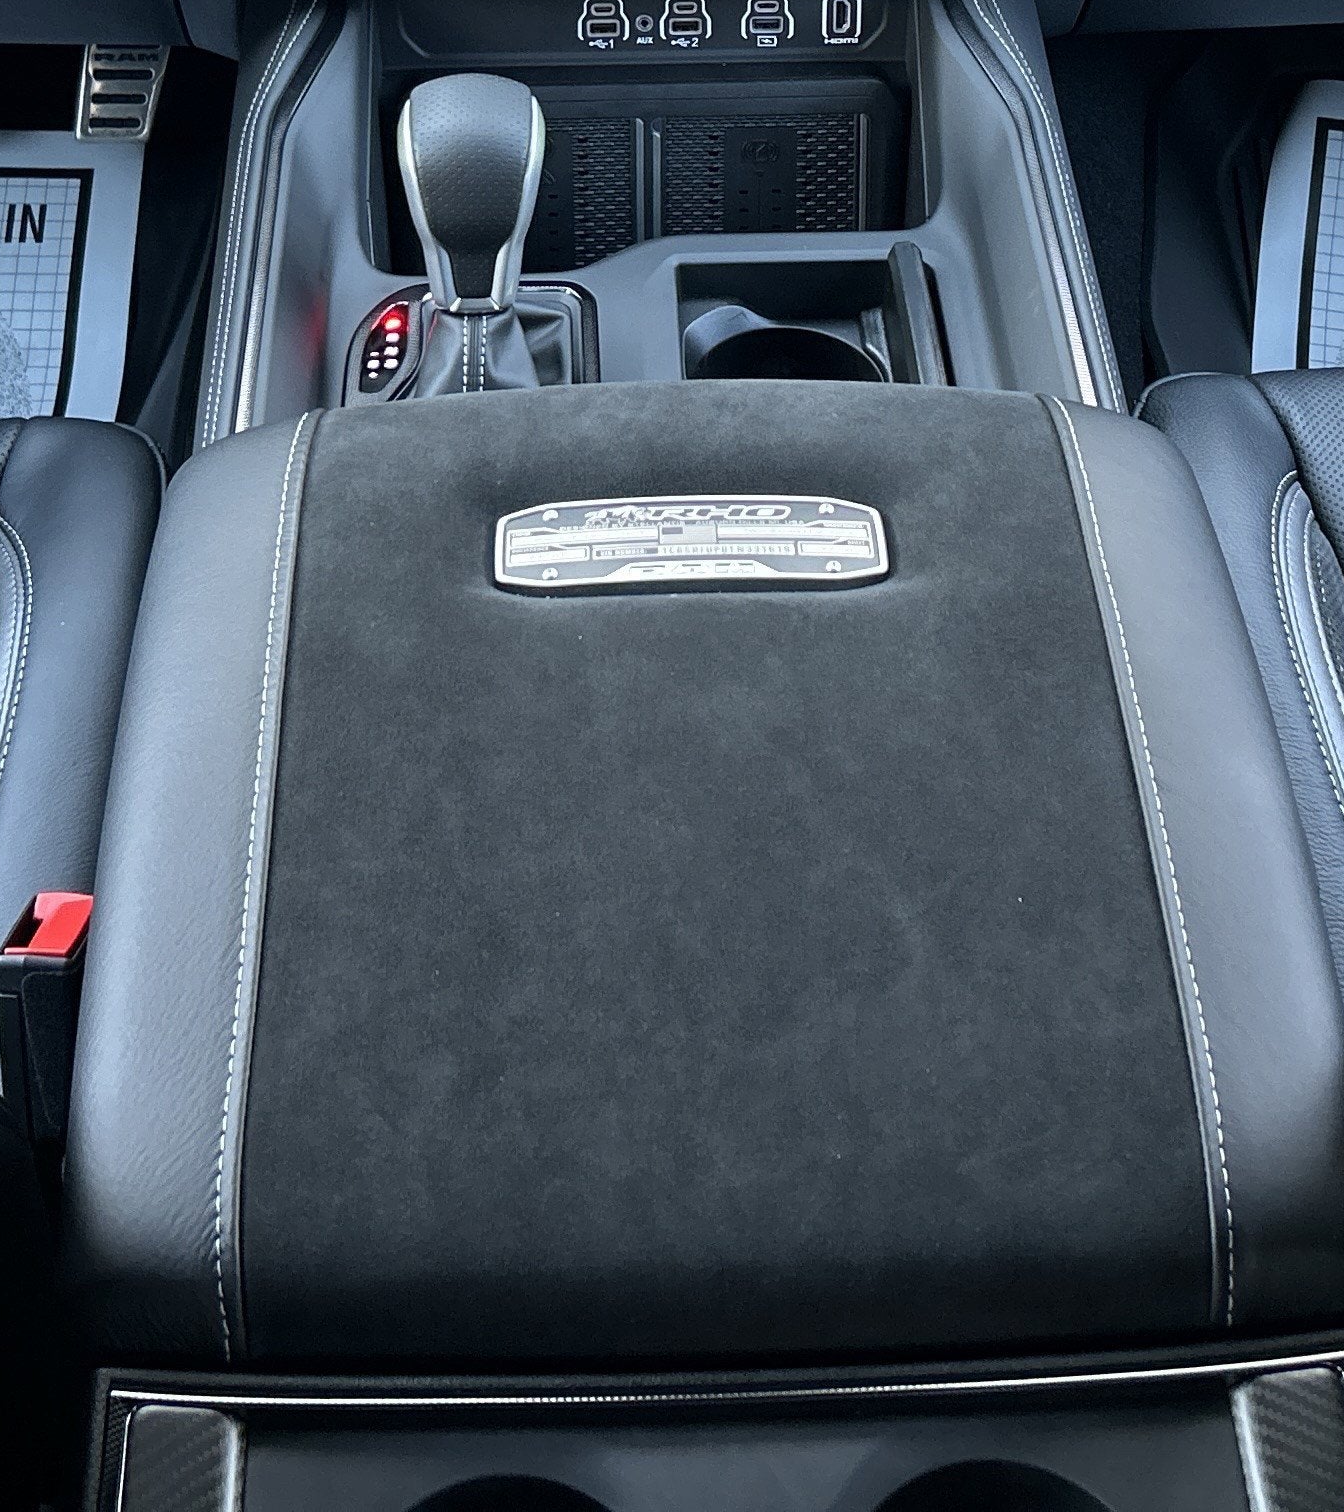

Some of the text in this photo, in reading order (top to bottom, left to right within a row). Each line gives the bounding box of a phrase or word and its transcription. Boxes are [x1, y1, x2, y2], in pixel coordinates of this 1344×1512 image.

[636, 37, 654, 45] AUX
[690, 37, 699, 48] 2
[94, 50, 160, 63] RAM
[4, 203, 48, 244] IN
